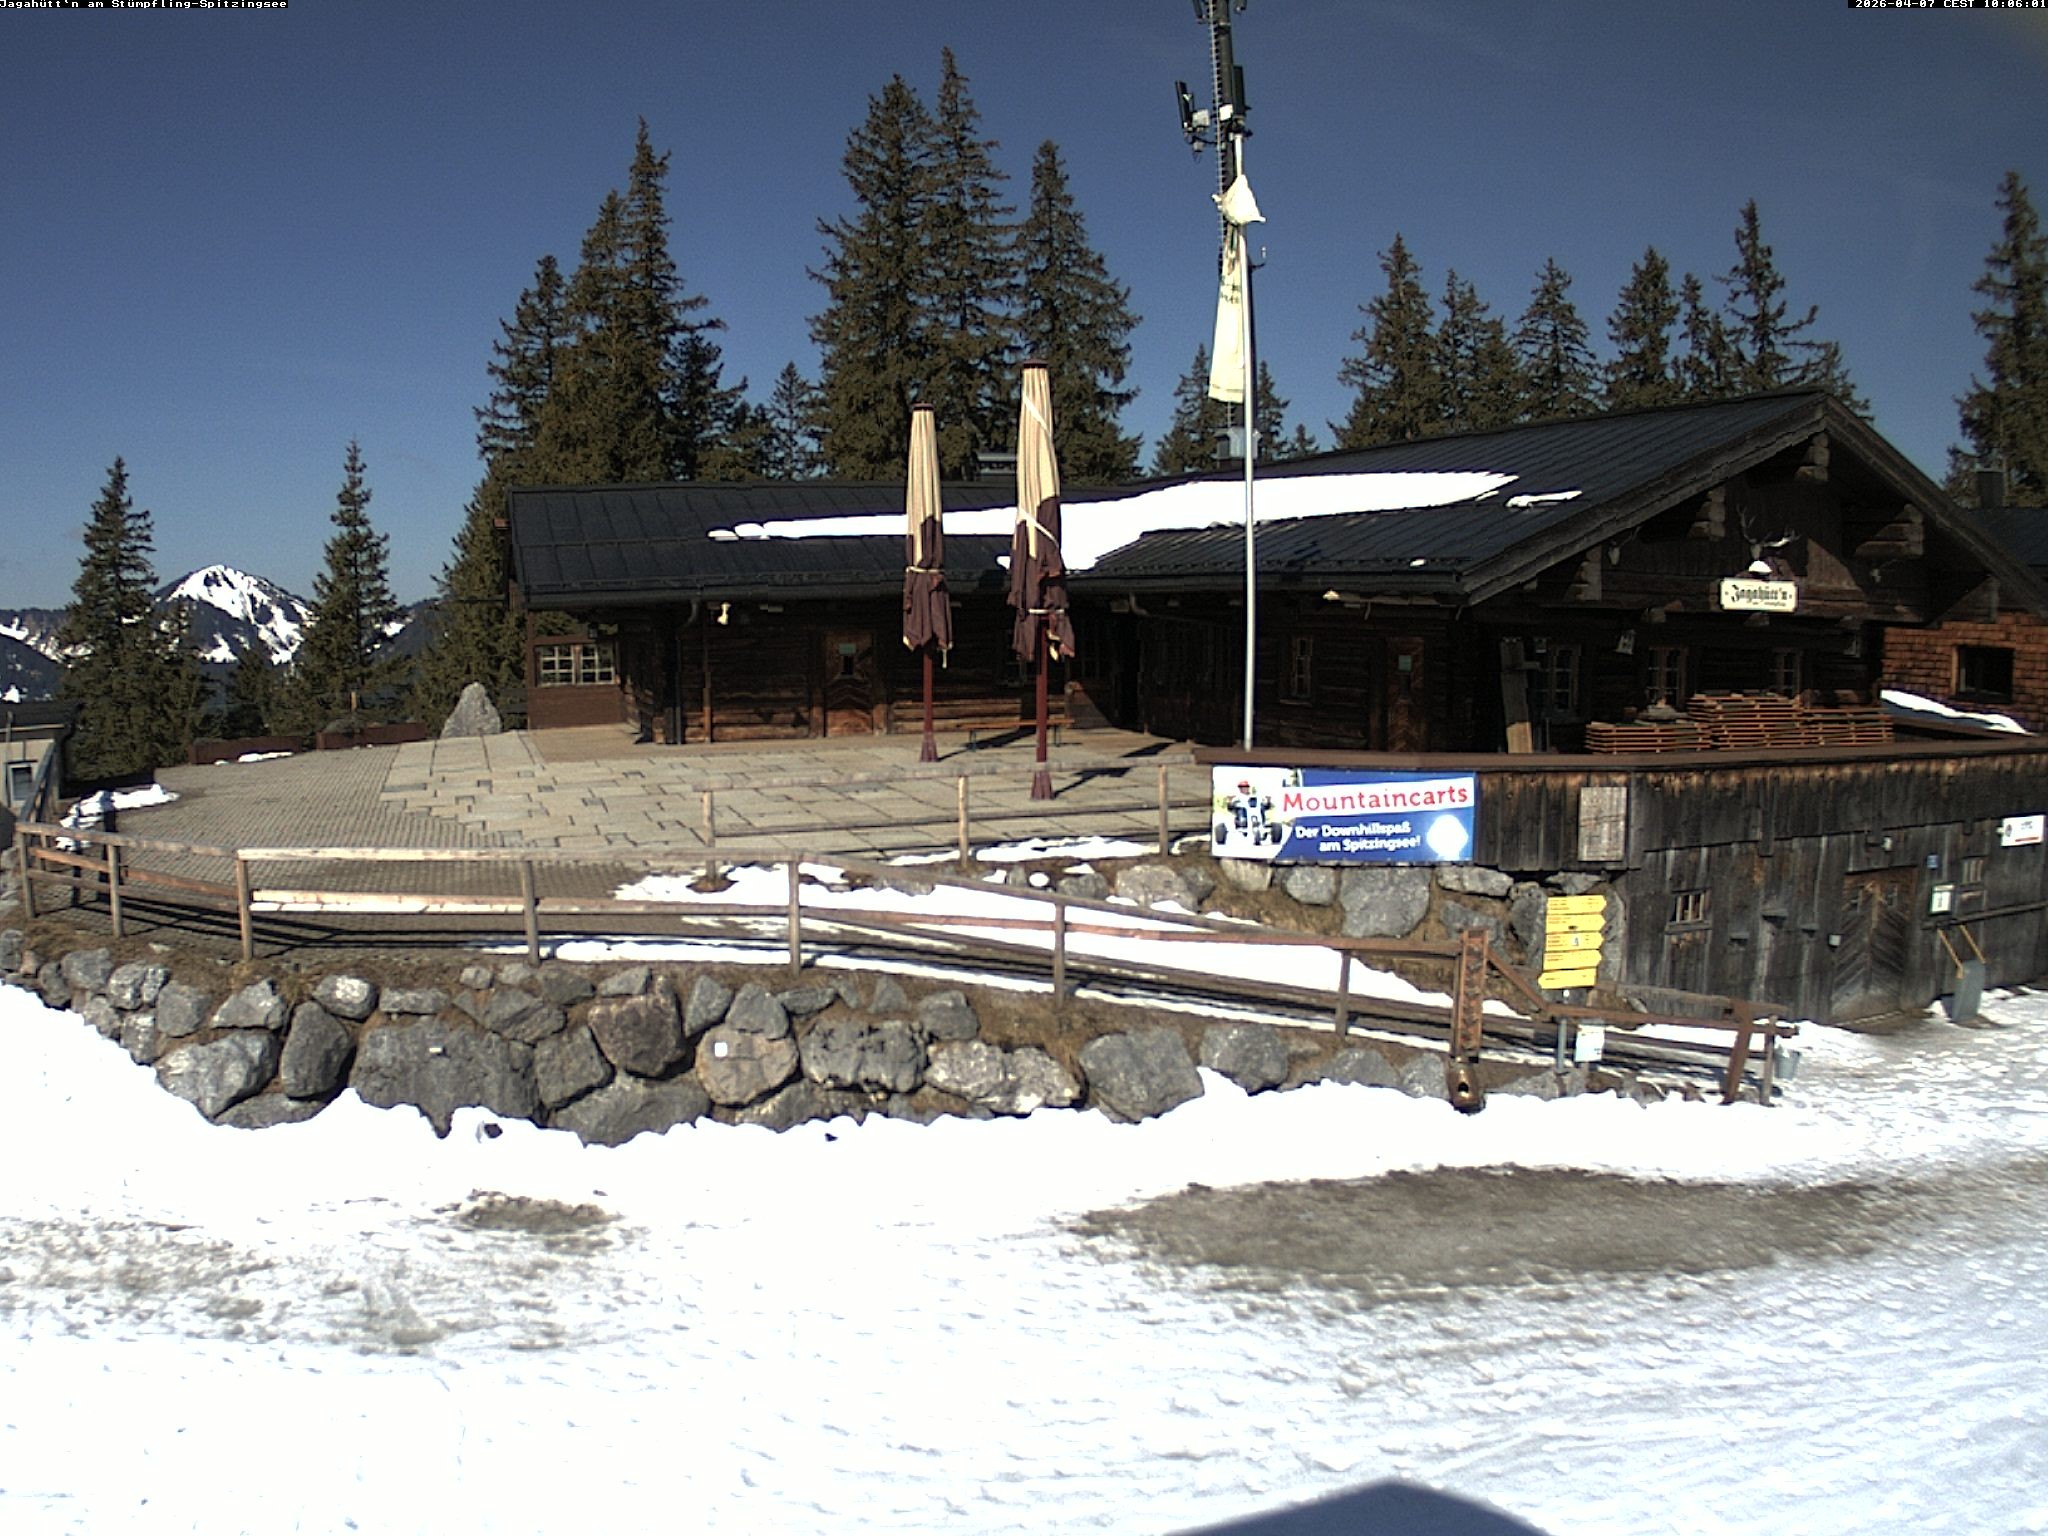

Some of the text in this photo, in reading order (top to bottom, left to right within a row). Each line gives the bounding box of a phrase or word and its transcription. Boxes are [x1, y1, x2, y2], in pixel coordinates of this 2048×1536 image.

[1283, 786, 1469, 812] Mountaincarts
[1295, 820, 1411, 839] Der Downhillspaß
[1319, 835, 1420, 853] am Spitzingsee!
